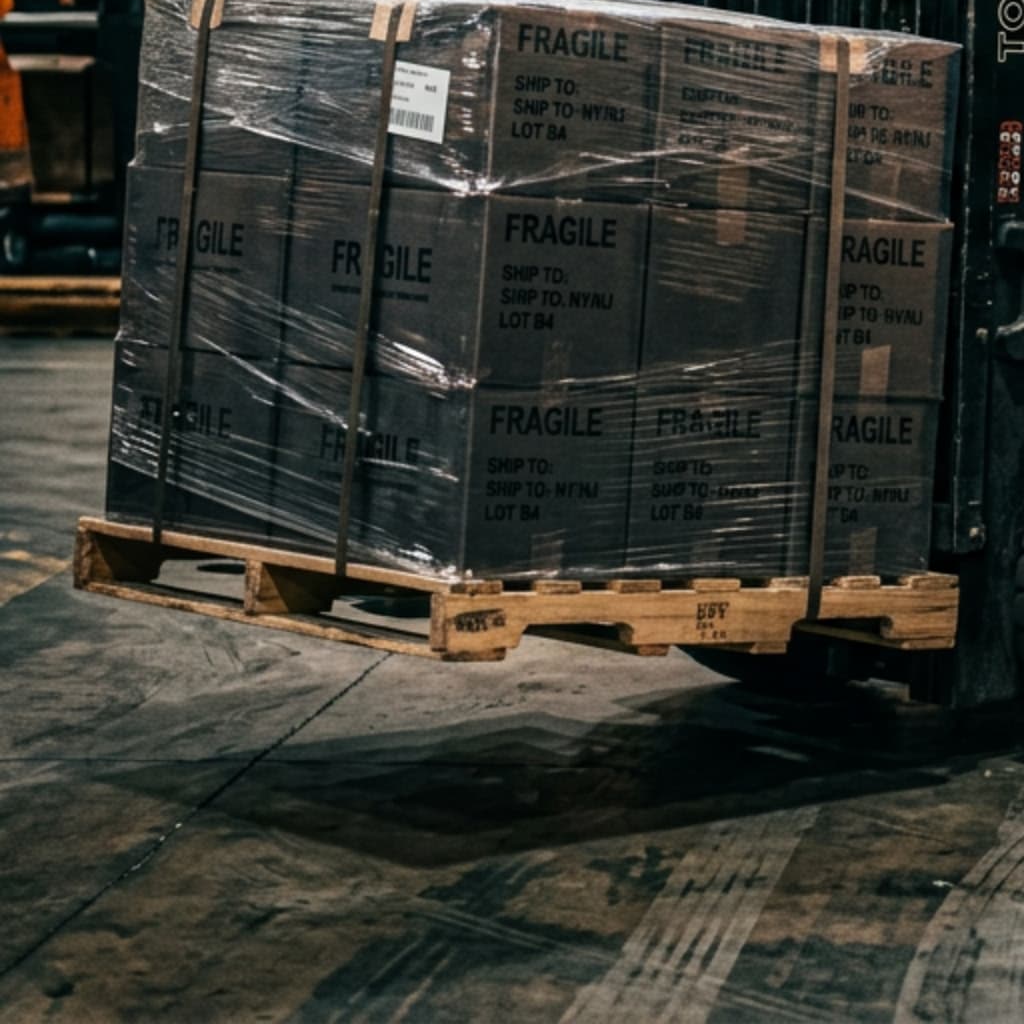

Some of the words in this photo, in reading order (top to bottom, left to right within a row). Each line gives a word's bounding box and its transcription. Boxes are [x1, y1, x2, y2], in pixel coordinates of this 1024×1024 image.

[518, 24, 629, 62] FRAGILE
[515, 75, 551, 93] SHIP
[513, 98, 548, 116] SHIP
[511, 122, 544, 139] LOT
[154, 216, 245, 257] FRGILE
[504, 213, 616, 248] FRAGILE
[331, 240, 433, 283] FRGILE
[841, 235, 926, 267] RAGILE
[501, 264, 539, 283] SHIP
[499, 312, 531, 329] LOT
[489, 405, 603, 437] FRAGILE
[656, 409, 761, 438] FRAGILE
[831, 416, 913, 445] RAGILE
[320, 424, 421, 461] FRGILE
[487, 457, 525, 475] SHIP
[485, 480, 523, 497] SHIP
[484, 504, 516, 521] LOT
[651, 503, 681, 521] LOT
